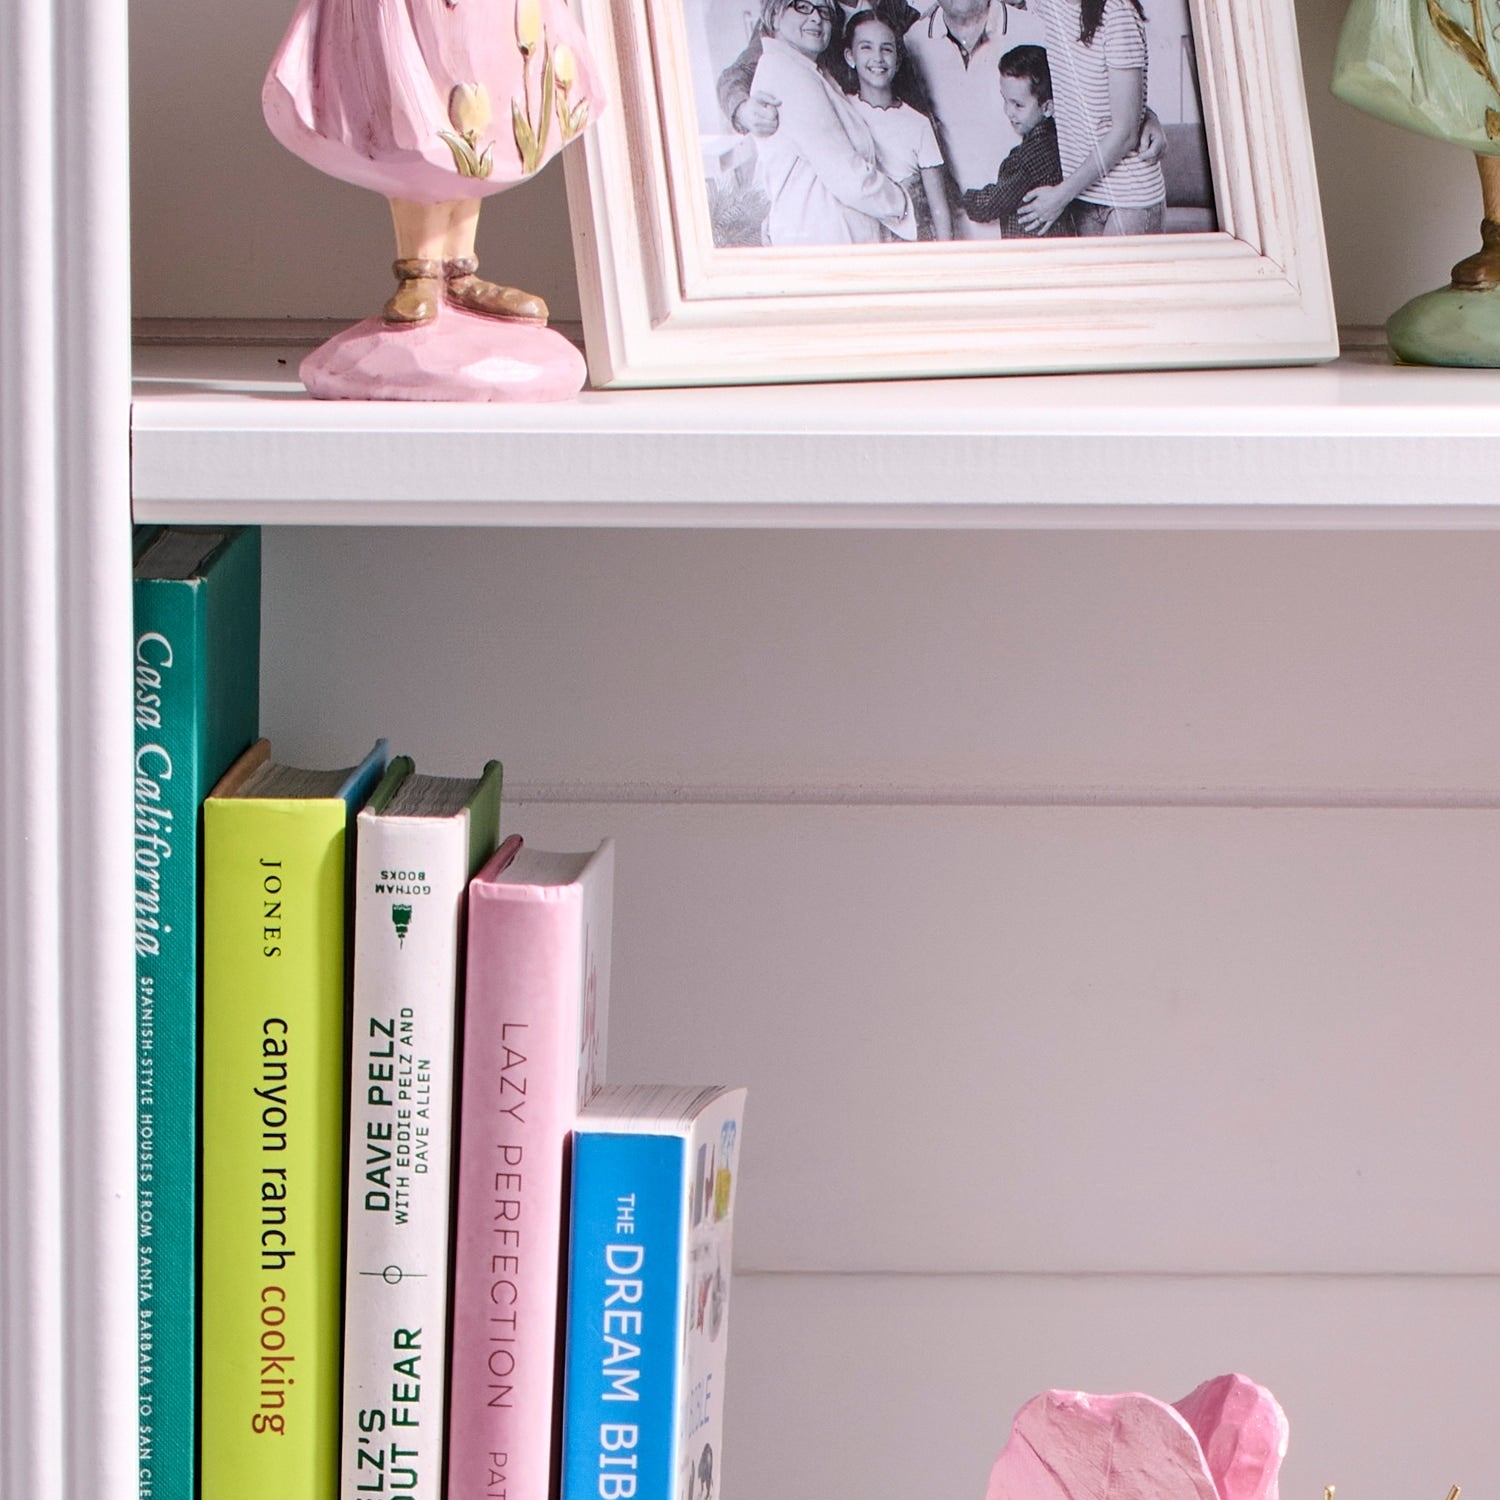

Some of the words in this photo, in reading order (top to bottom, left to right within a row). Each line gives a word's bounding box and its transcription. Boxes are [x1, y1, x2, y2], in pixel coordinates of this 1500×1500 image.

[135, 632, 173, 732] Casa
[134, 744, 172, 957] California
[380, 870, 425, 881] BOOKS
[259, 858, 282, 958] JONES
[375, 884, 431, 895] GOTHAM
[140, 977, 154, 1105] SPANISH-STYLE
[367, 1017, 395, 1106] PELZ
[399, 1007, 414, 1046] AND
[253, 1018, 288, 1151] canyon
[398, 1054, 413, 1100] PELZ
[416, 1059, 431, 1119] ALLEN
[498, 1022, 527, 1122] LAZY
[140, 1114, 154, 1182] HOUSES
[364, 1121, 393, 1212] DAVE
[396, 1109, 411, 1167] EDDIE
[414, 1127, 430, 1174] DAVE
[140, 1190, 153, 1238] FROM
[261, 1168, 296, 1270] ranch
[395, 1176, 409, 1225] WITH
[616, 1193, 636, 1234] THE
[140, 1246, 153, 1302] SANTA
[487, 1145, 523, 1408] PERFECTION
[139, 1309, 152, 1386] BARBARA
[601, 1244, 644, 1401] DREAM
[251, 1286, 295, 1436] cooking
[391, 1328, 422, 1427] FEAR
[139, 1394, 152, 1416] TO
[139, 1425, 152, 1459] SAN
